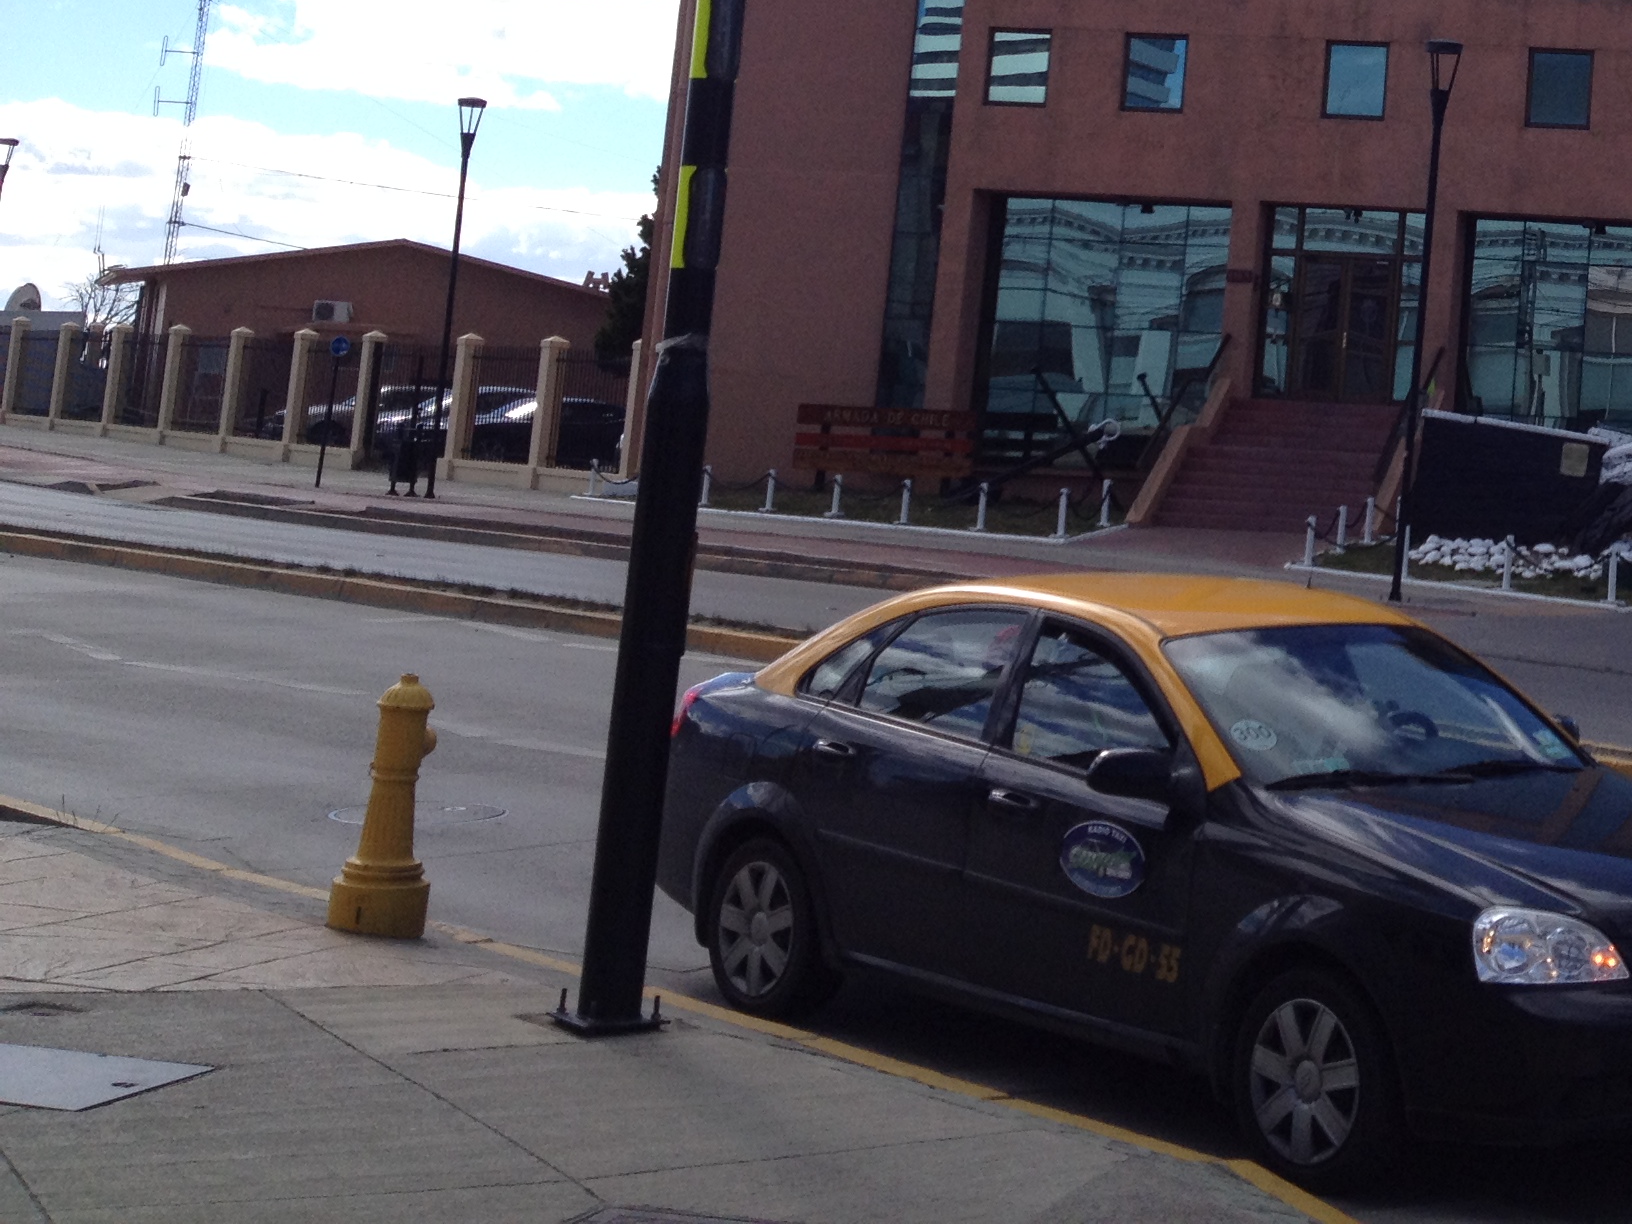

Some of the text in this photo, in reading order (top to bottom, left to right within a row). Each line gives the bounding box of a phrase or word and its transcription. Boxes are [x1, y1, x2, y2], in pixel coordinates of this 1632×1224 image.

[823, 409, 951, 427] ARMADA DE CHILE
